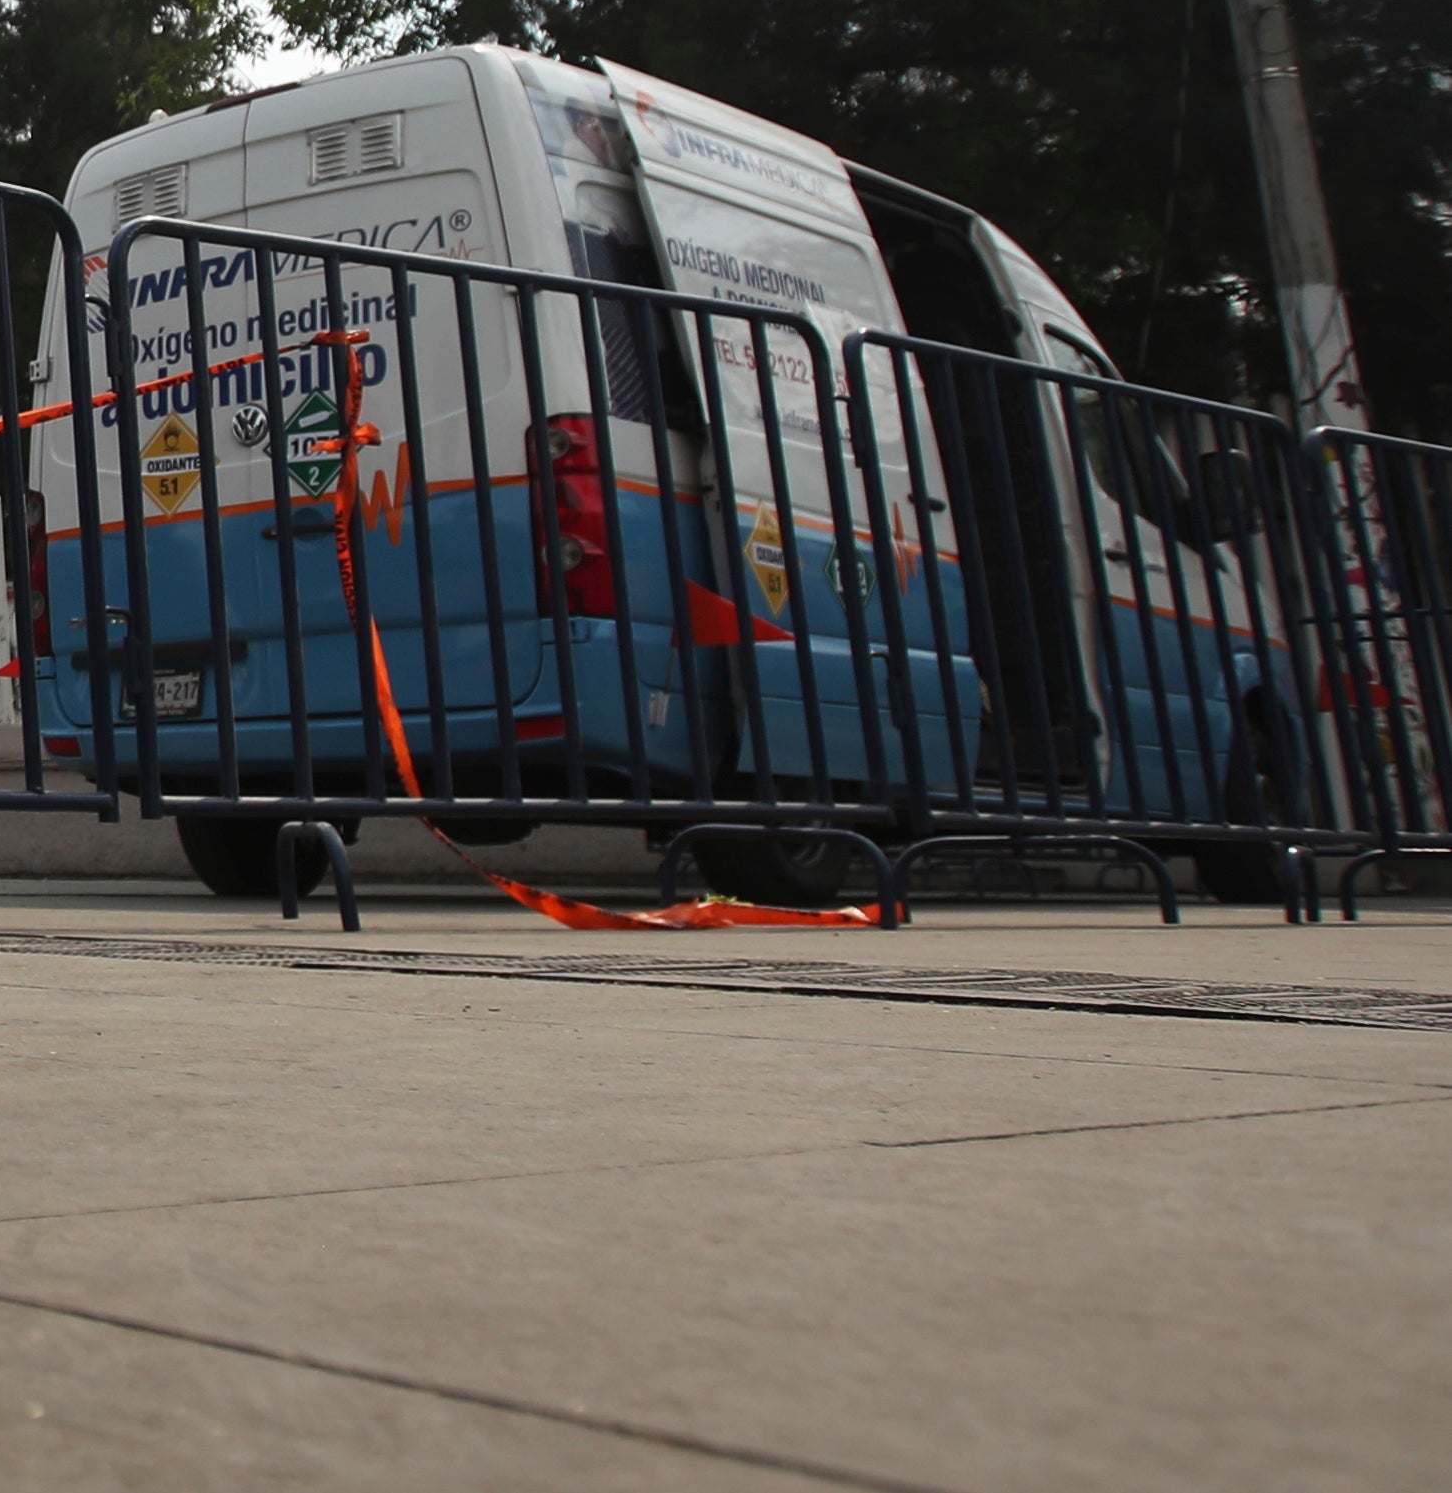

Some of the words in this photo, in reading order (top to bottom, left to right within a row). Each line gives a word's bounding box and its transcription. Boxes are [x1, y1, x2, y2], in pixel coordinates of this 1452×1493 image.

[667, 237, 740, 284] OXÍGENO
[247, 283, 417, 342] mediinal
[142, 343, 387, 420] domicilo
[147, 457, 201, 474] OXIDANTE
[309, 466, 320, 486] 2
[160, 478, 178, 497] 5.1
